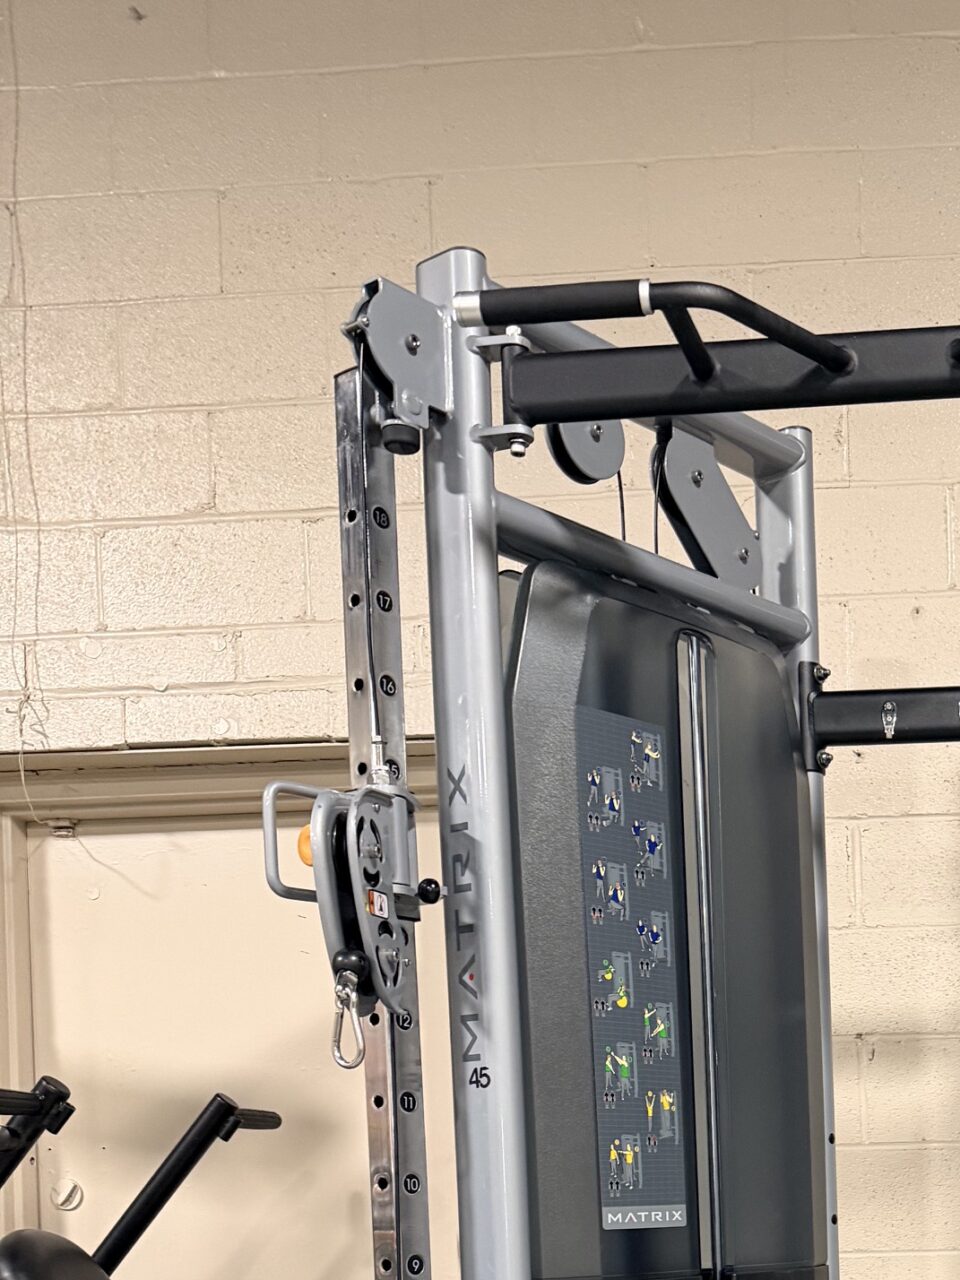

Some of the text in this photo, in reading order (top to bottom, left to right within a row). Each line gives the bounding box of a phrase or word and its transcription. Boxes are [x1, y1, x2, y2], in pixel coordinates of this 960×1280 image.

[375, 510, 387, 526] 18
[378, 595, 390, 609] 17
[382, 679, 394, 694] 16
[447, 763, 481, 1062] MATRIX
[399, 1014, 411, 1027] 12
[468, 1066, 491, 1089] 45
[403, 1096, 413, 1110] 11
[406, 1178, 419, 1191] 10
[607, 1210, 682, 1224] MATRIX
[412, 1259, 419, 1272] 9
